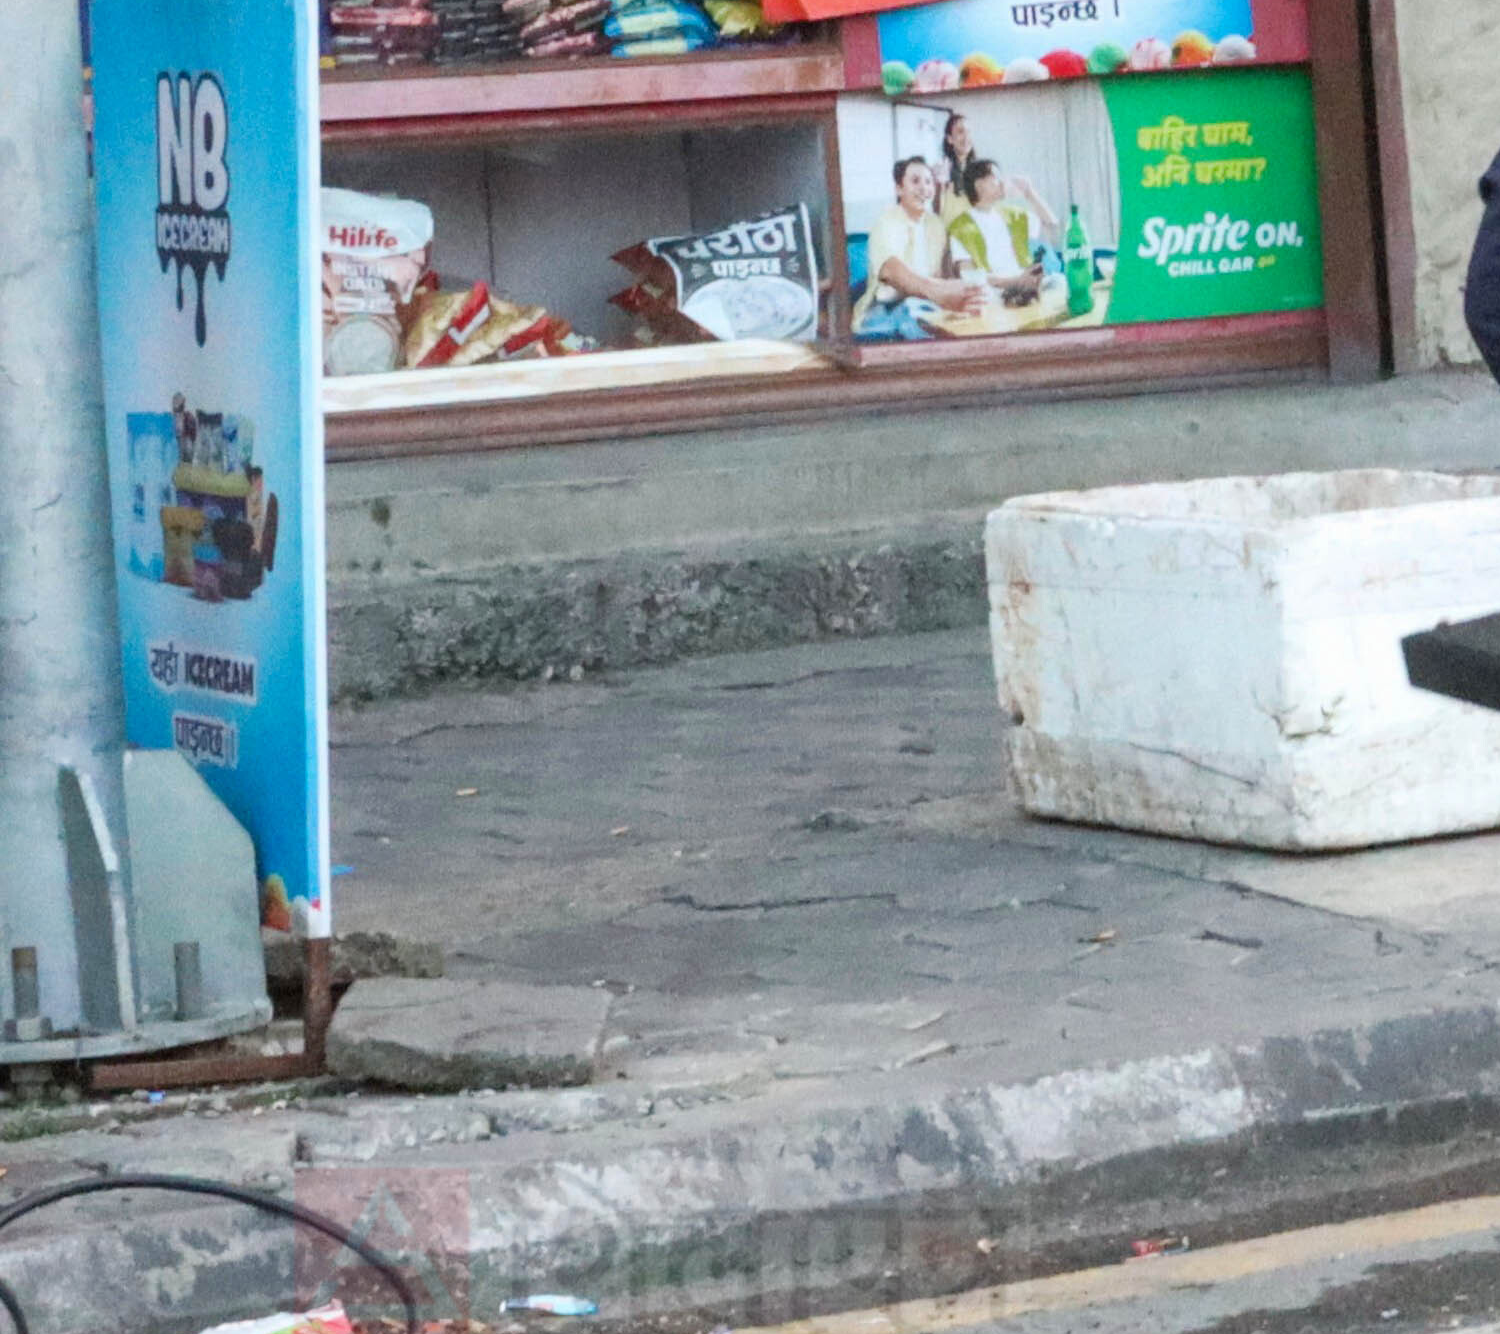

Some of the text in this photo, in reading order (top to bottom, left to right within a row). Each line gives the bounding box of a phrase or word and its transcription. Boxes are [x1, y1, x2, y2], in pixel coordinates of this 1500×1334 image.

[157, 71, 230, 211] NB
[156, 212, 231, 254] ICECREAM
[328, 225, 399, 249] Hilife
[1137, 211, 1304, 266] Sprite ON,
[1168, 259, 1215, 278] CHILL
[184, 652, 255, 698] ICECREAM
